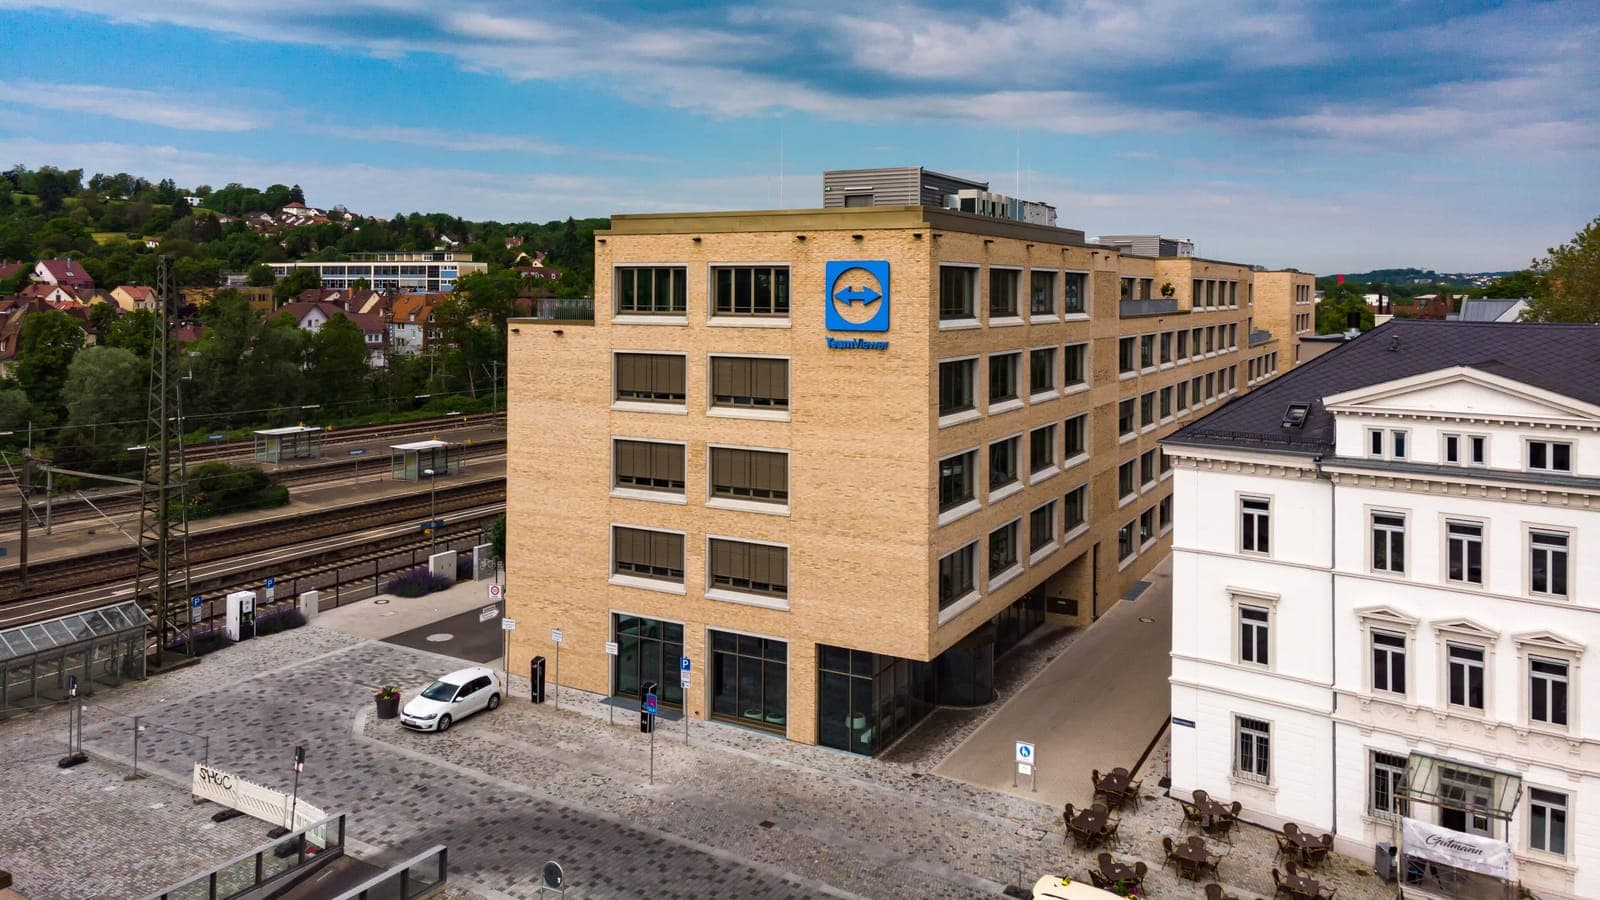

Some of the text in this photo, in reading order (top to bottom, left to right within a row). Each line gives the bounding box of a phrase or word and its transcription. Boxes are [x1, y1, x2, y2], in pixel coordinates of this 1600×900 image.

[826, 336, 889, 350] TeamViewer
[682, 659, 689, 669] P
[1425, 834, 1483, 856] Gutmann
